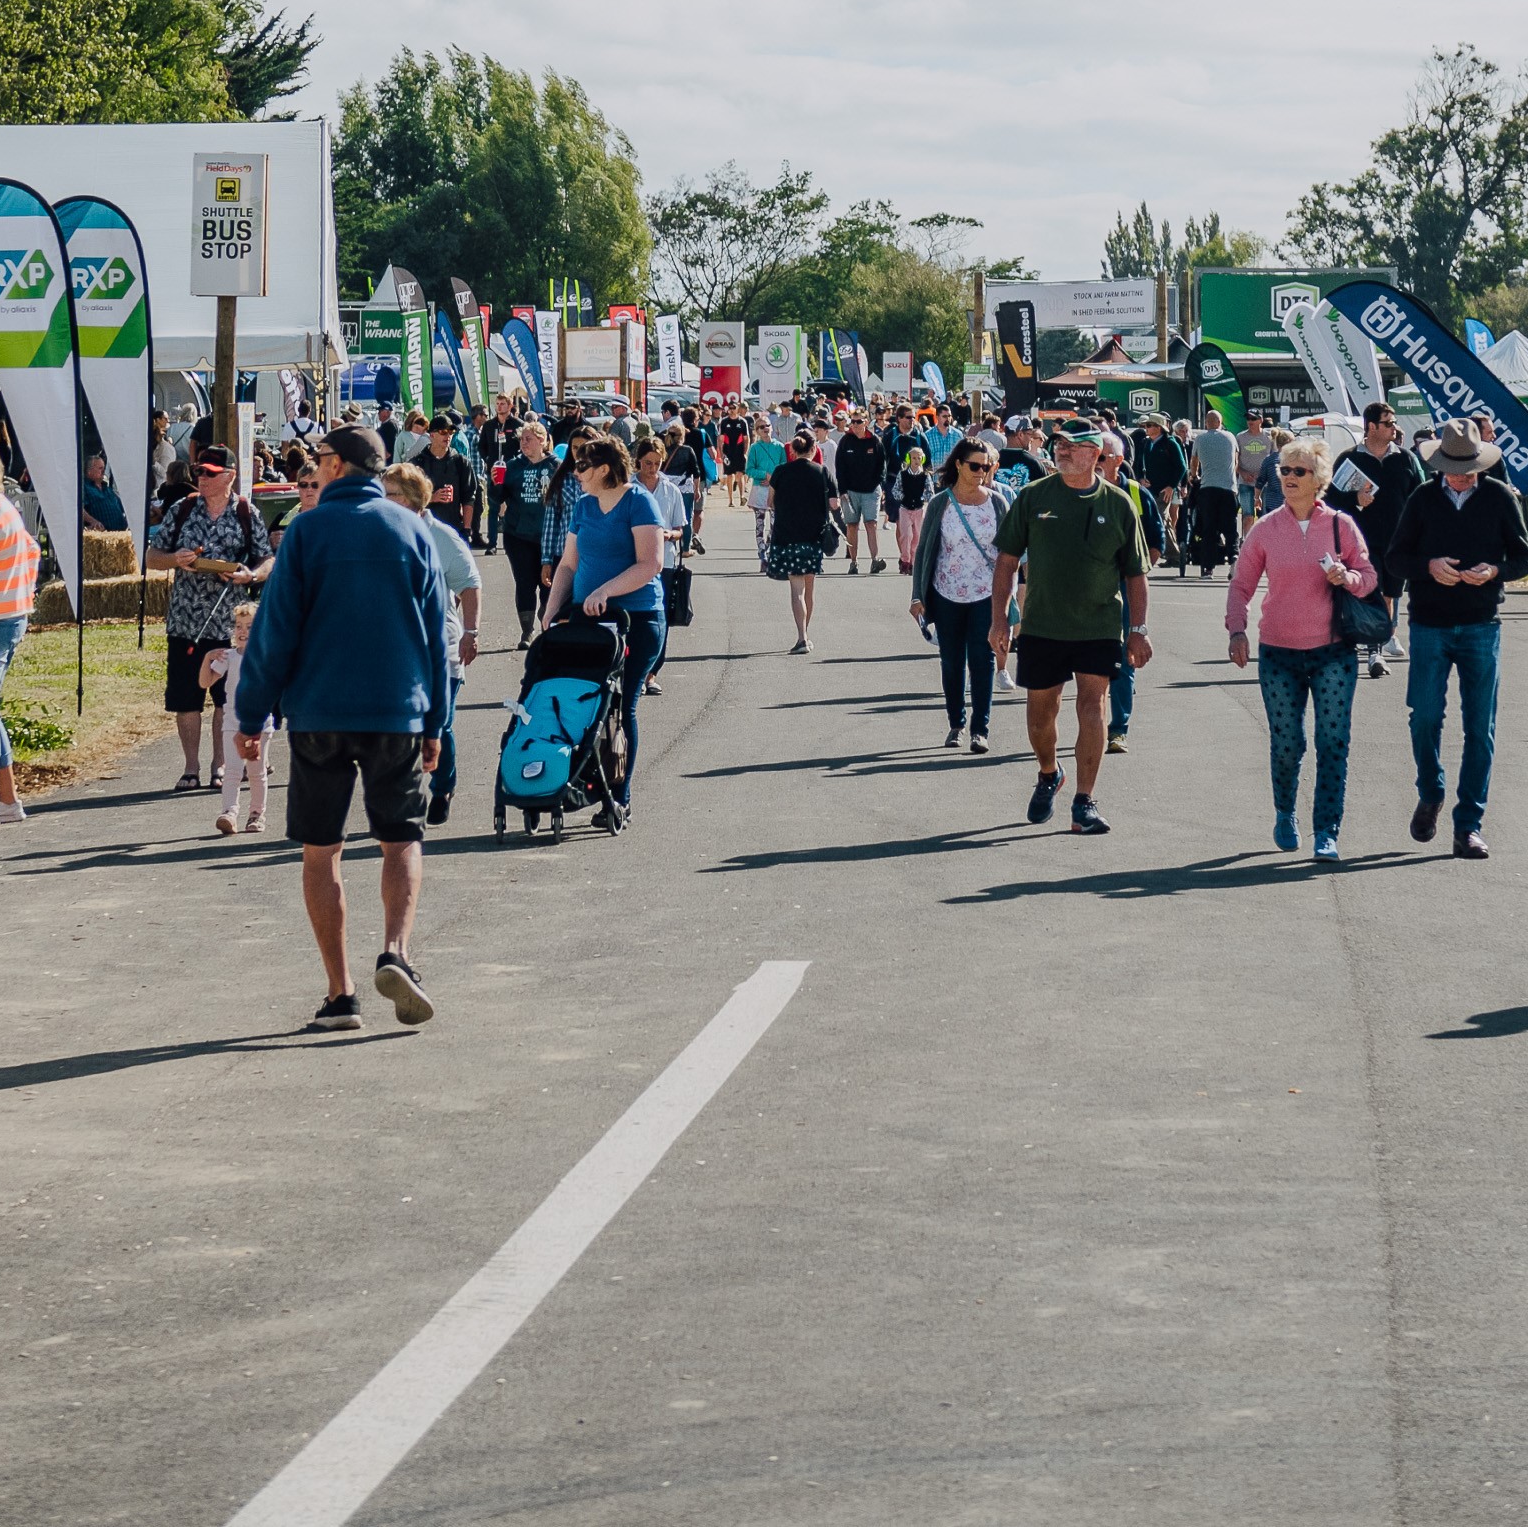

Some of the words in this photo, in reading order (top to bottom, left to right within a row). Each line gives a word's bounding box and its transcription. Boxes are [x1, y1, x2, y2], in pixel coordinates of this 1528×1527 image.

[202, 207, 253, 218] SHUTTLE
[202, 219, 252, 241] BUS
[201, 242, 252, 259] STOP
[73, 264, 125, 291] RXP
[1073, 292, 1093, 300] STOCK
[1, 305, 10, 314] by
[11, 305, 37, 314] aliaxis
[81, 304, 90, 312] by
[1116, 306, 1145, 314] SOLUTIONS
[365, 320, 381, 328] THE
[365, 329, 403, 339] WRANG
[1020, 307, 1032, 365] Coresteel
[1329, 323, 1370, 391] vegepod
[1204, 364, 1219, 374] DTS
[1134, 396, 1154, 407] DTS
